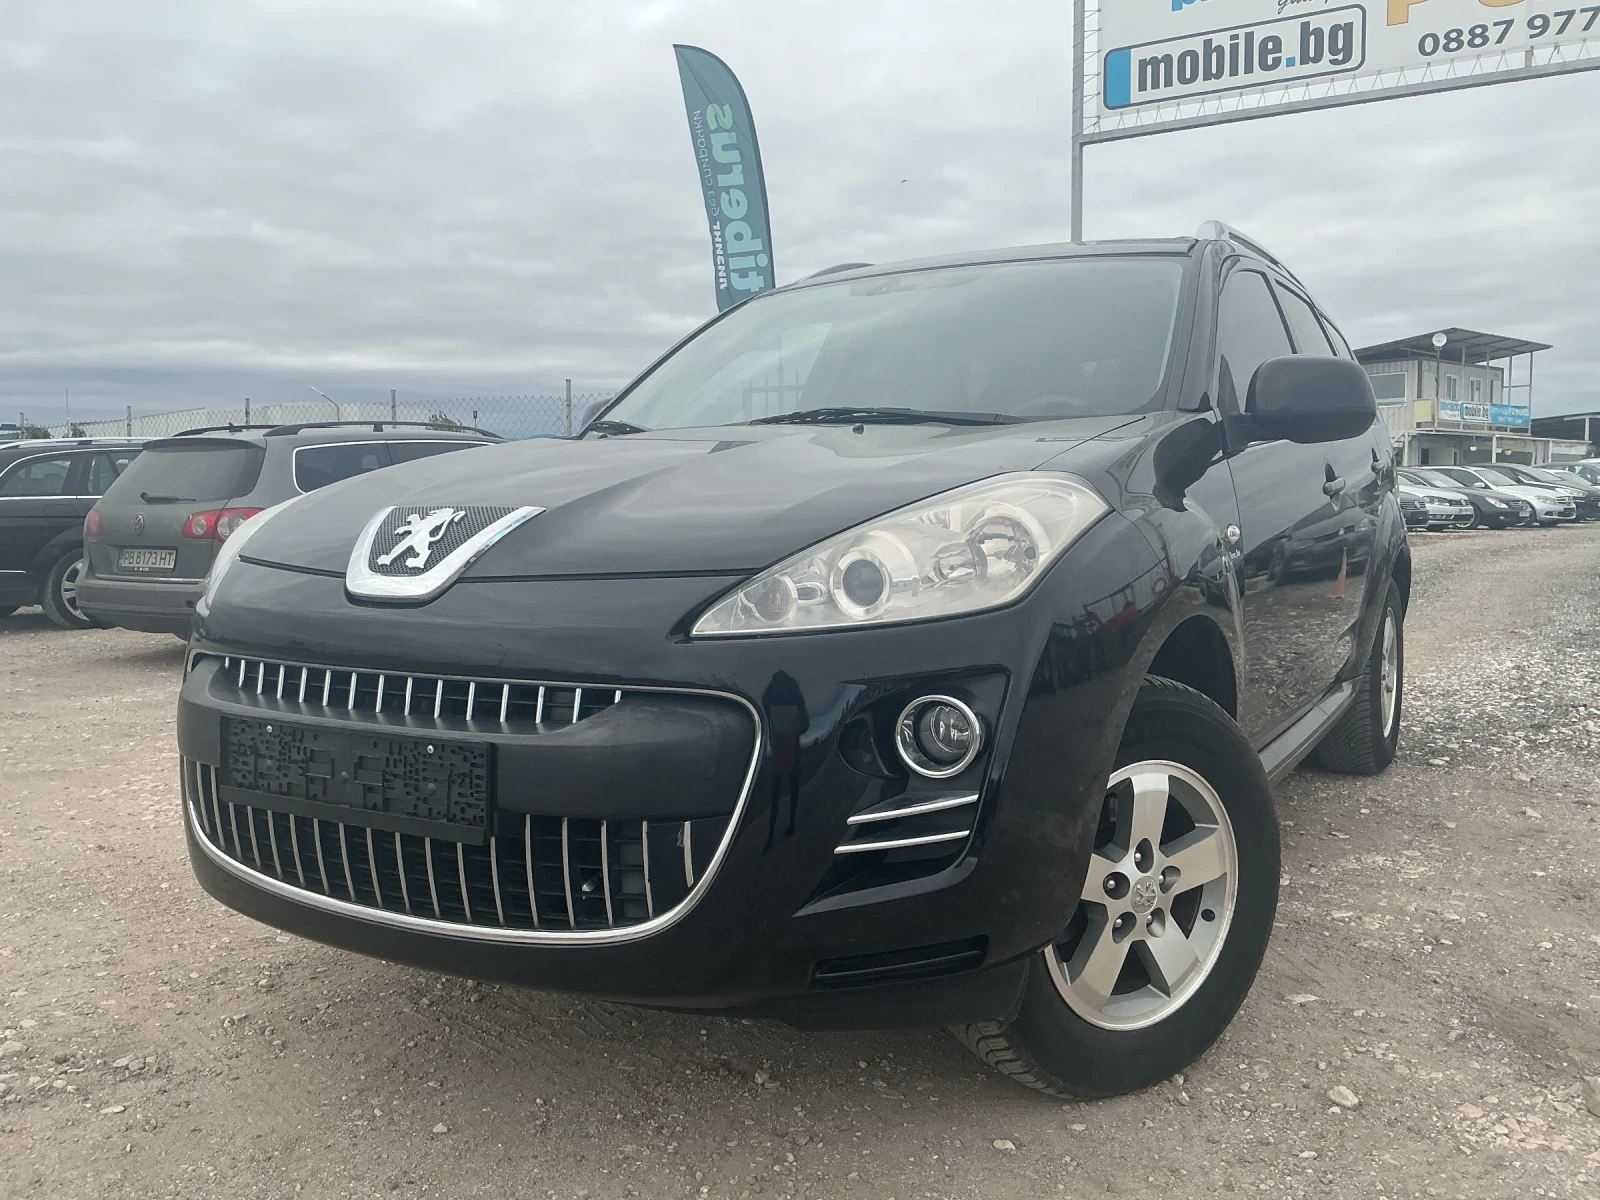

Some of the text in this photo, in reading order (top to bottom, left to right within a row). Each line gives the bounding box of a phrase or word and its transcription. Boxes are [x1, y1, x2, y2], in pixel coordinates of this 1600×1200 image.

[1137, 20, 1354, 92] mobile.bg
[1417, 18, 1515, 57] 0887
[1526, 5, 1600, 39] 977
